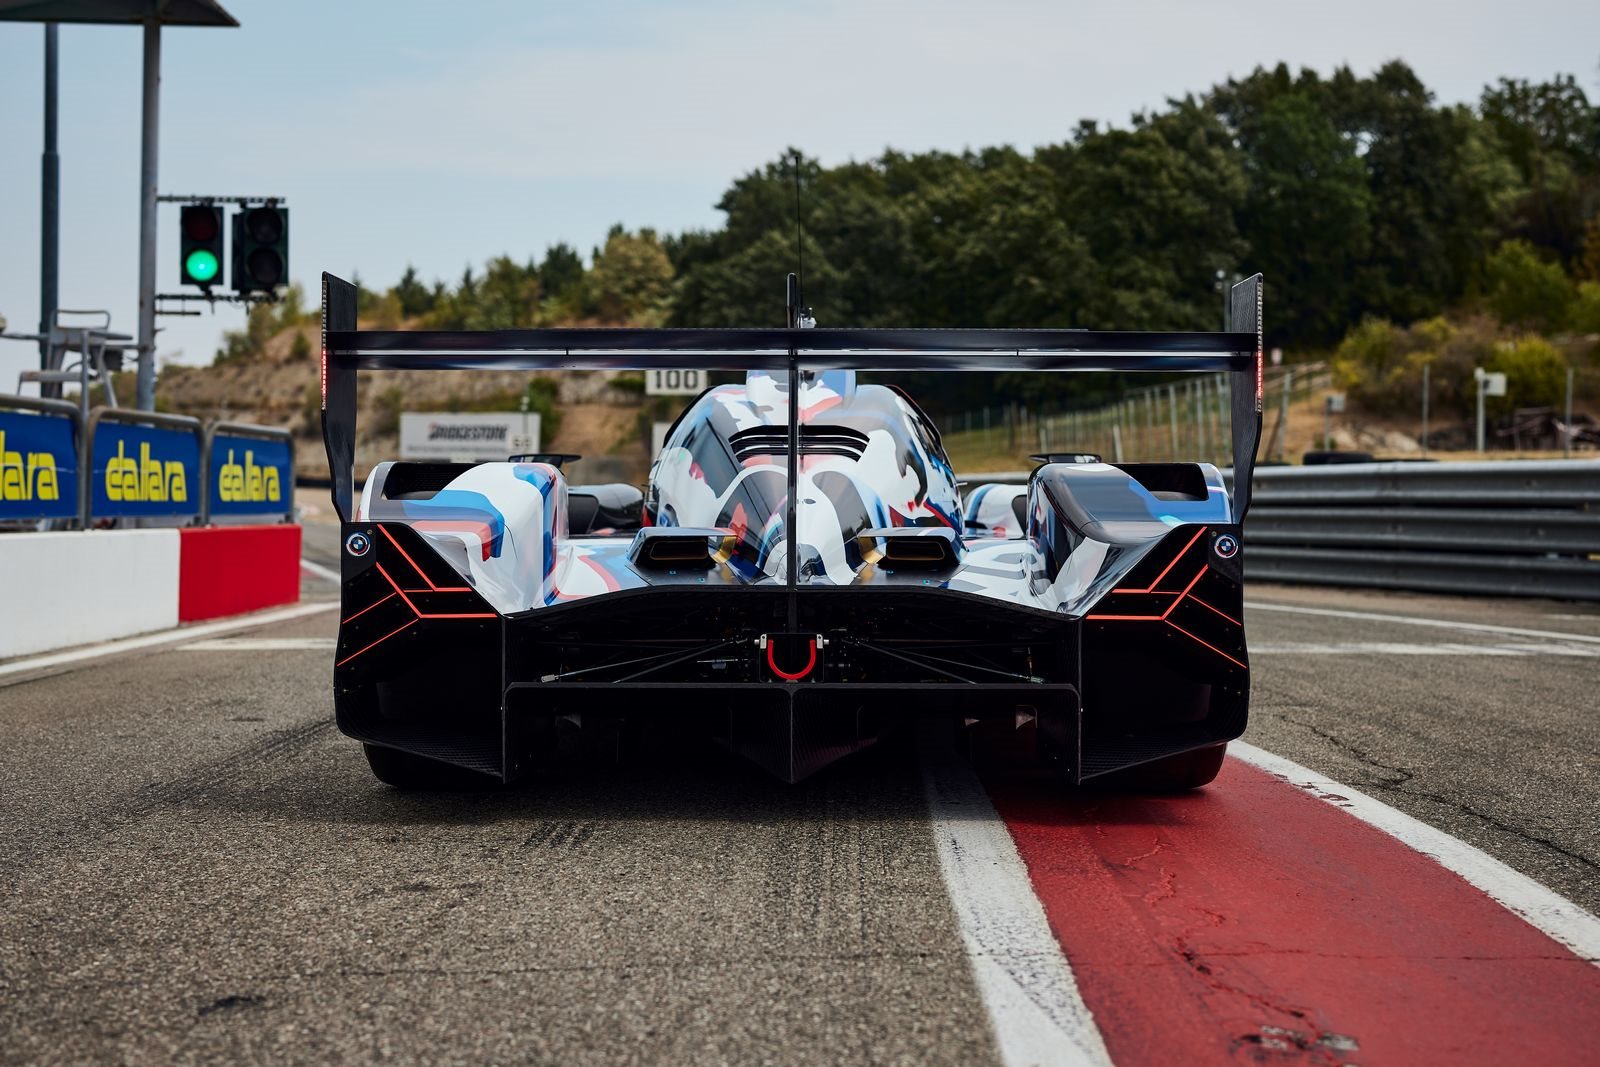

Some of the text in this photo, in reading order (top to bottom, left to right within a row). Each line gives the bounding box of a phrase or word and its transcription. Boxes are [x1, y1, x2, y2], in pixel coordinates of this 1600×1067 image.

[656, 370, 698, 389] 100
[105, 439, 187, 501] dallara
[219, 448, 281, 501] dallara
